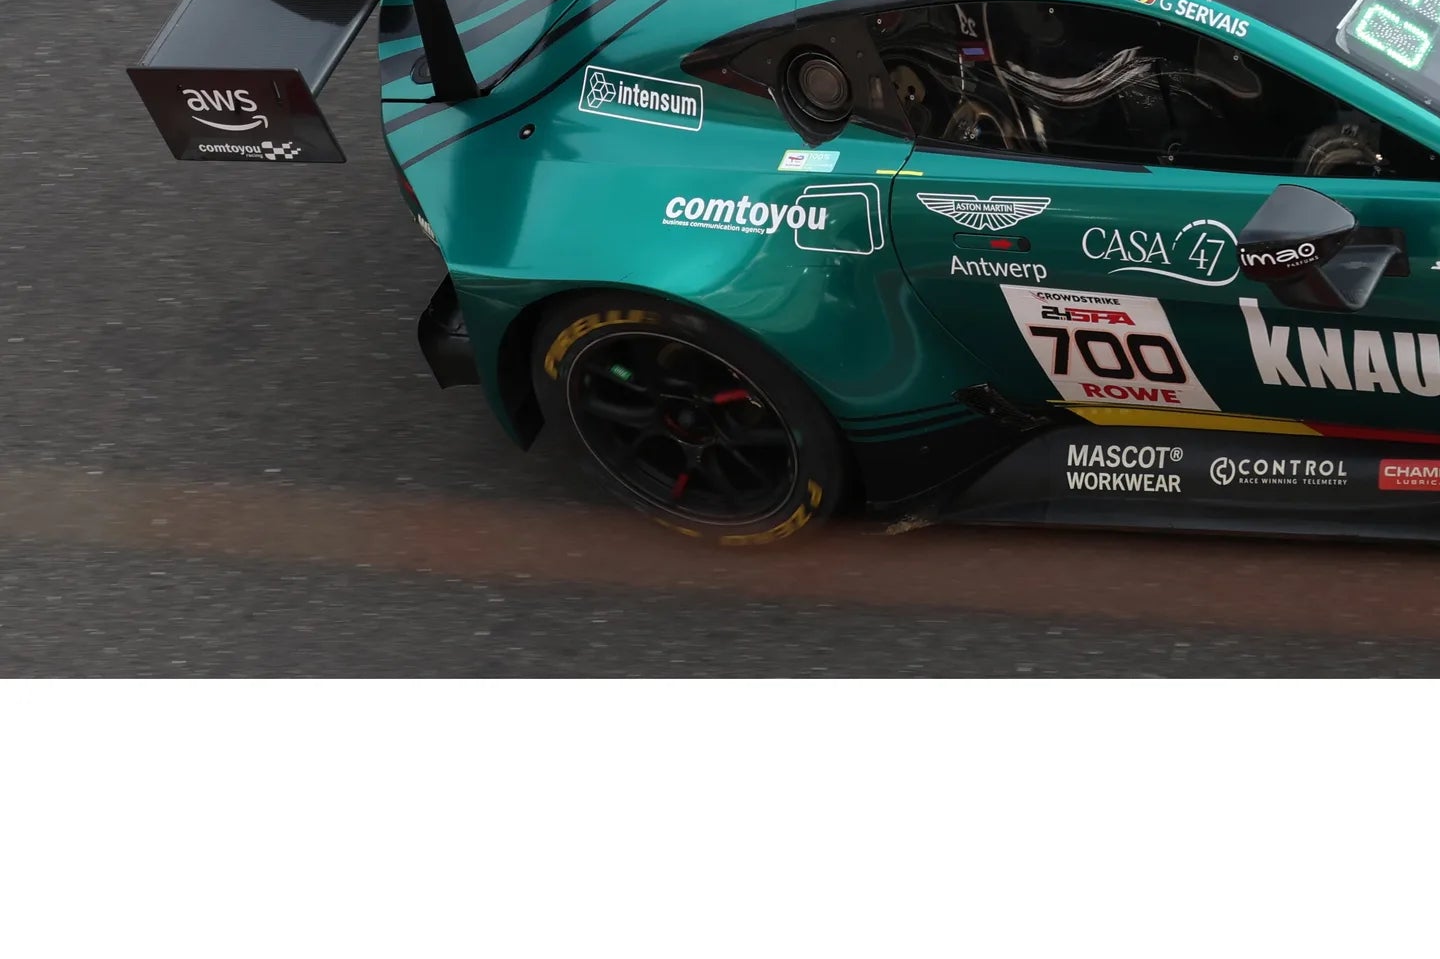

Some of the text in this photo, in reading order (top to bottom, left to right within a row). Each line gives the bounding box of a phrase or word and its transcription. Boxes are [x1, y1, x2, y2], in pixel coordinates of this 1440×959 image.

[1175, 0, 1250, 38] SERVAIS
[181, 87, 258, 112] aws
[617, 82, 697, 117] intensum
[199, 142, 261, 158] comtoyou
[665, 195, 827, 234] comtoyou
[956, 202, 1013, 213] ASTON MARTIN
[662, 218, 765, 235] business communication agency
[1082, 227, 1225, 276] CASA 47
[950, 255, 1047, 282] Antwerp
[1036, 291, 1121, 306] CROWDSTRIKE
[1029, 326, 1187, 384] 700
[1082, 382, 1182, 404] ROWE
[1238, 459, 1347, 477] CONTROL
[1066, 472, 1181, 493] WORKWEAR
[1303, 478, 1347, 486] TELEMETRY
